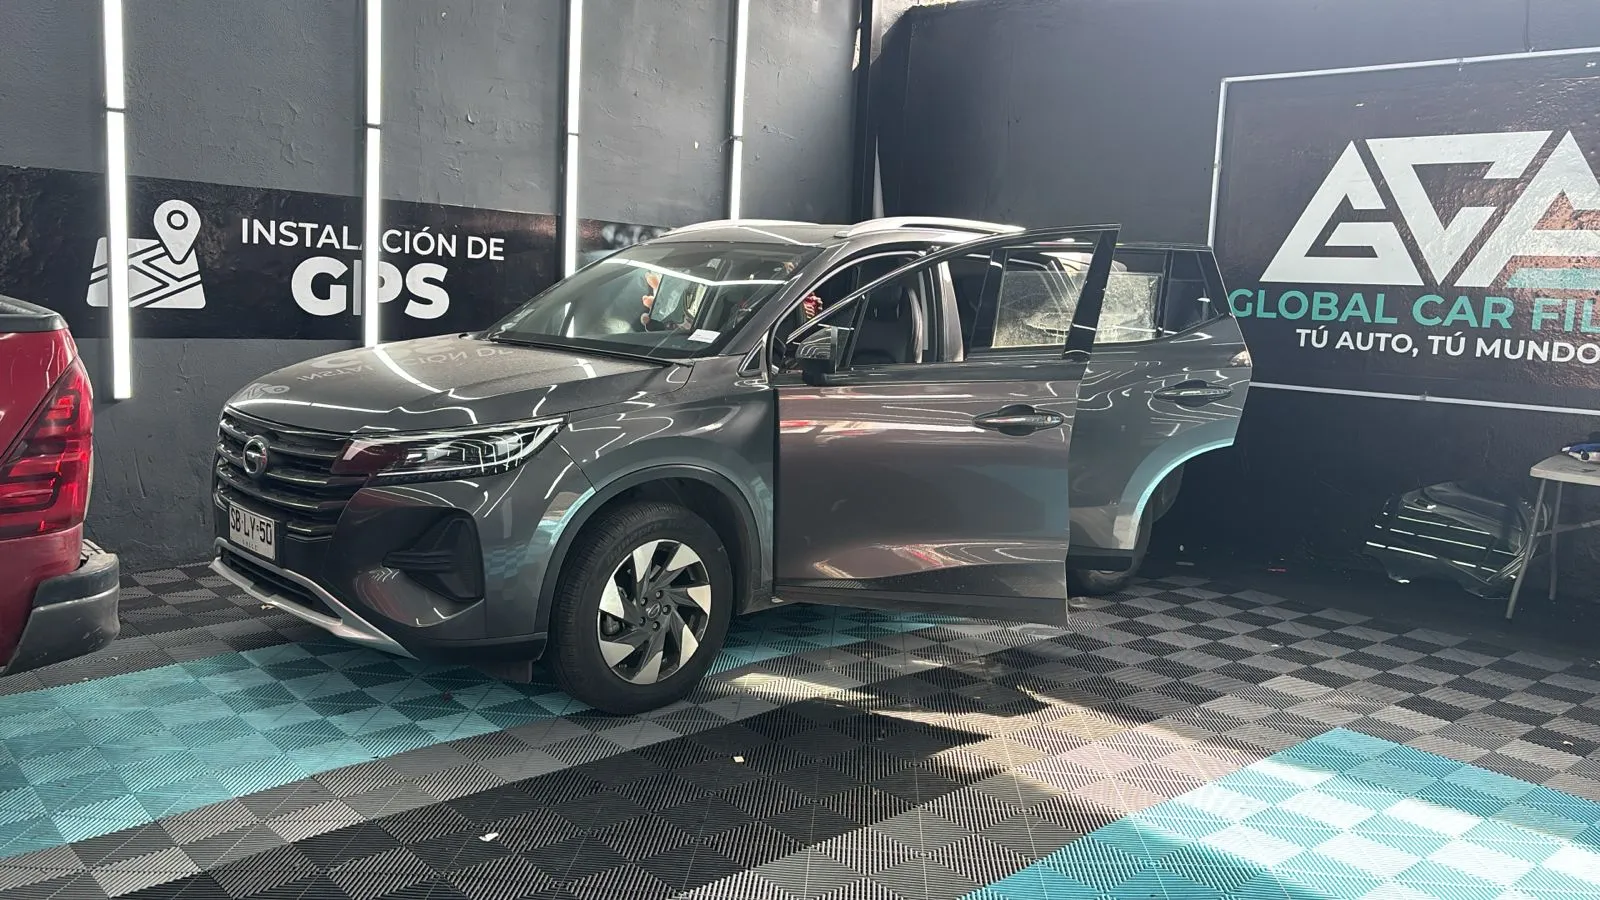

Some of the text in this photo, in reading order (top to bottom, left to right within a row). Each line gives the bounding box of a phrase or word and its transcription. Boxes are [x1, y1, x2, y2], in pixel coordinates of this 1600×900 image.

[242, 218, 505, 260] INSTALCIÓN DE
[291, 256, 450, 319] GPS
[1229, 288, 1600, 334] GLOBAL CAR FIL
[1296, 325, 1600, 364] TÚ AUTO, TÚ MUNDO
